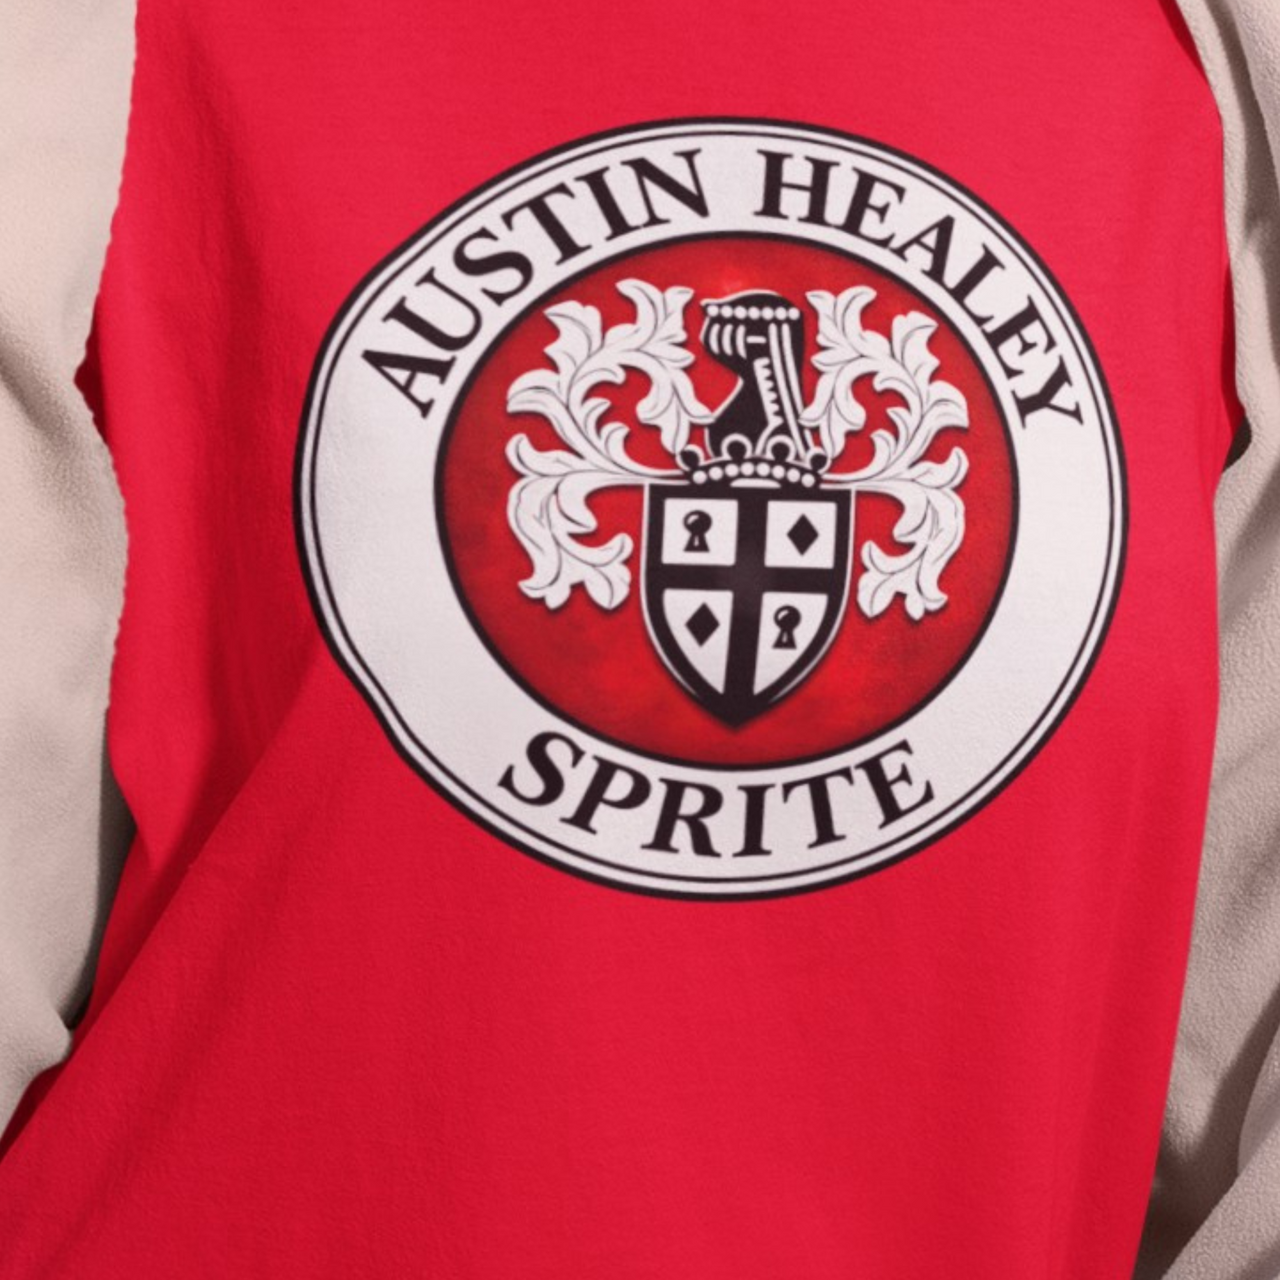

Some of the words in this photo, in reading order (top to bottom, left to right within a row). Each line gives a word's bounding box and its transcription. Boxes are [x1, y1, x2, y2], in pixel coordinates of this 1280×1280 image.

[361, 148, 711, 418] AUSTIN
[753, 149, 1083, 429] HEALEY
[497, 730, 935, 858] SPRITE
